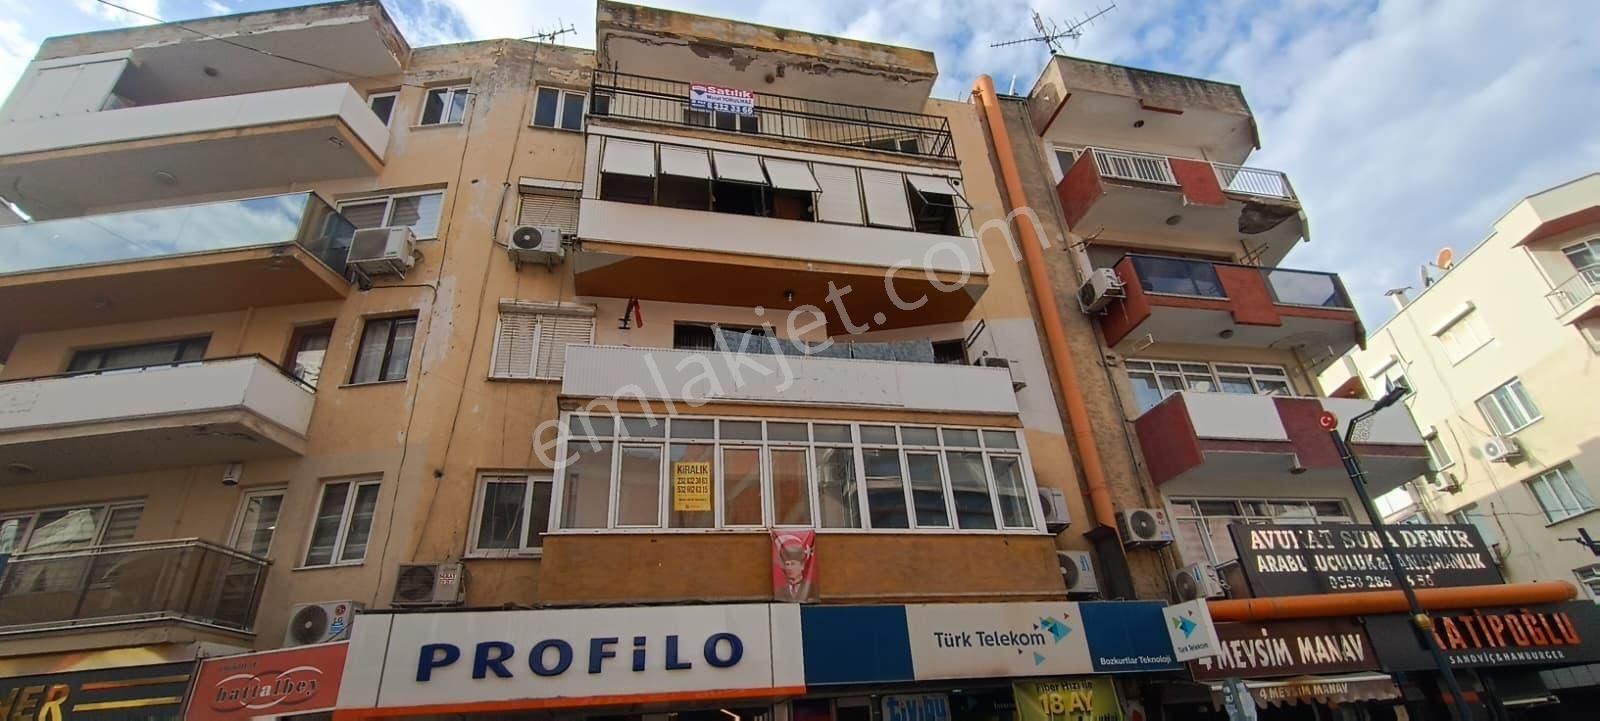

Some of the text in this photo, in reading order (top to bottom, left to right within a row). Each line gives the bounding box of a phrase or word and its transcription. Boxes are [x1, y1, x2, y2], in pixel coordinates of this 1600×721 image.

[1400, 525, 1475, 549] DEMİR
[933, 630, 1045, 648] Türk Telekom
[1216, 627, 1294, 670] MEVSİM
[1297, 633, 1365, 665] MANAV
[1100, 656, 1138, 665] Bozkurtlar
[1313, 682, 1348, 696] MANAV
[1038, 690, 1094, 715] 18 AY
